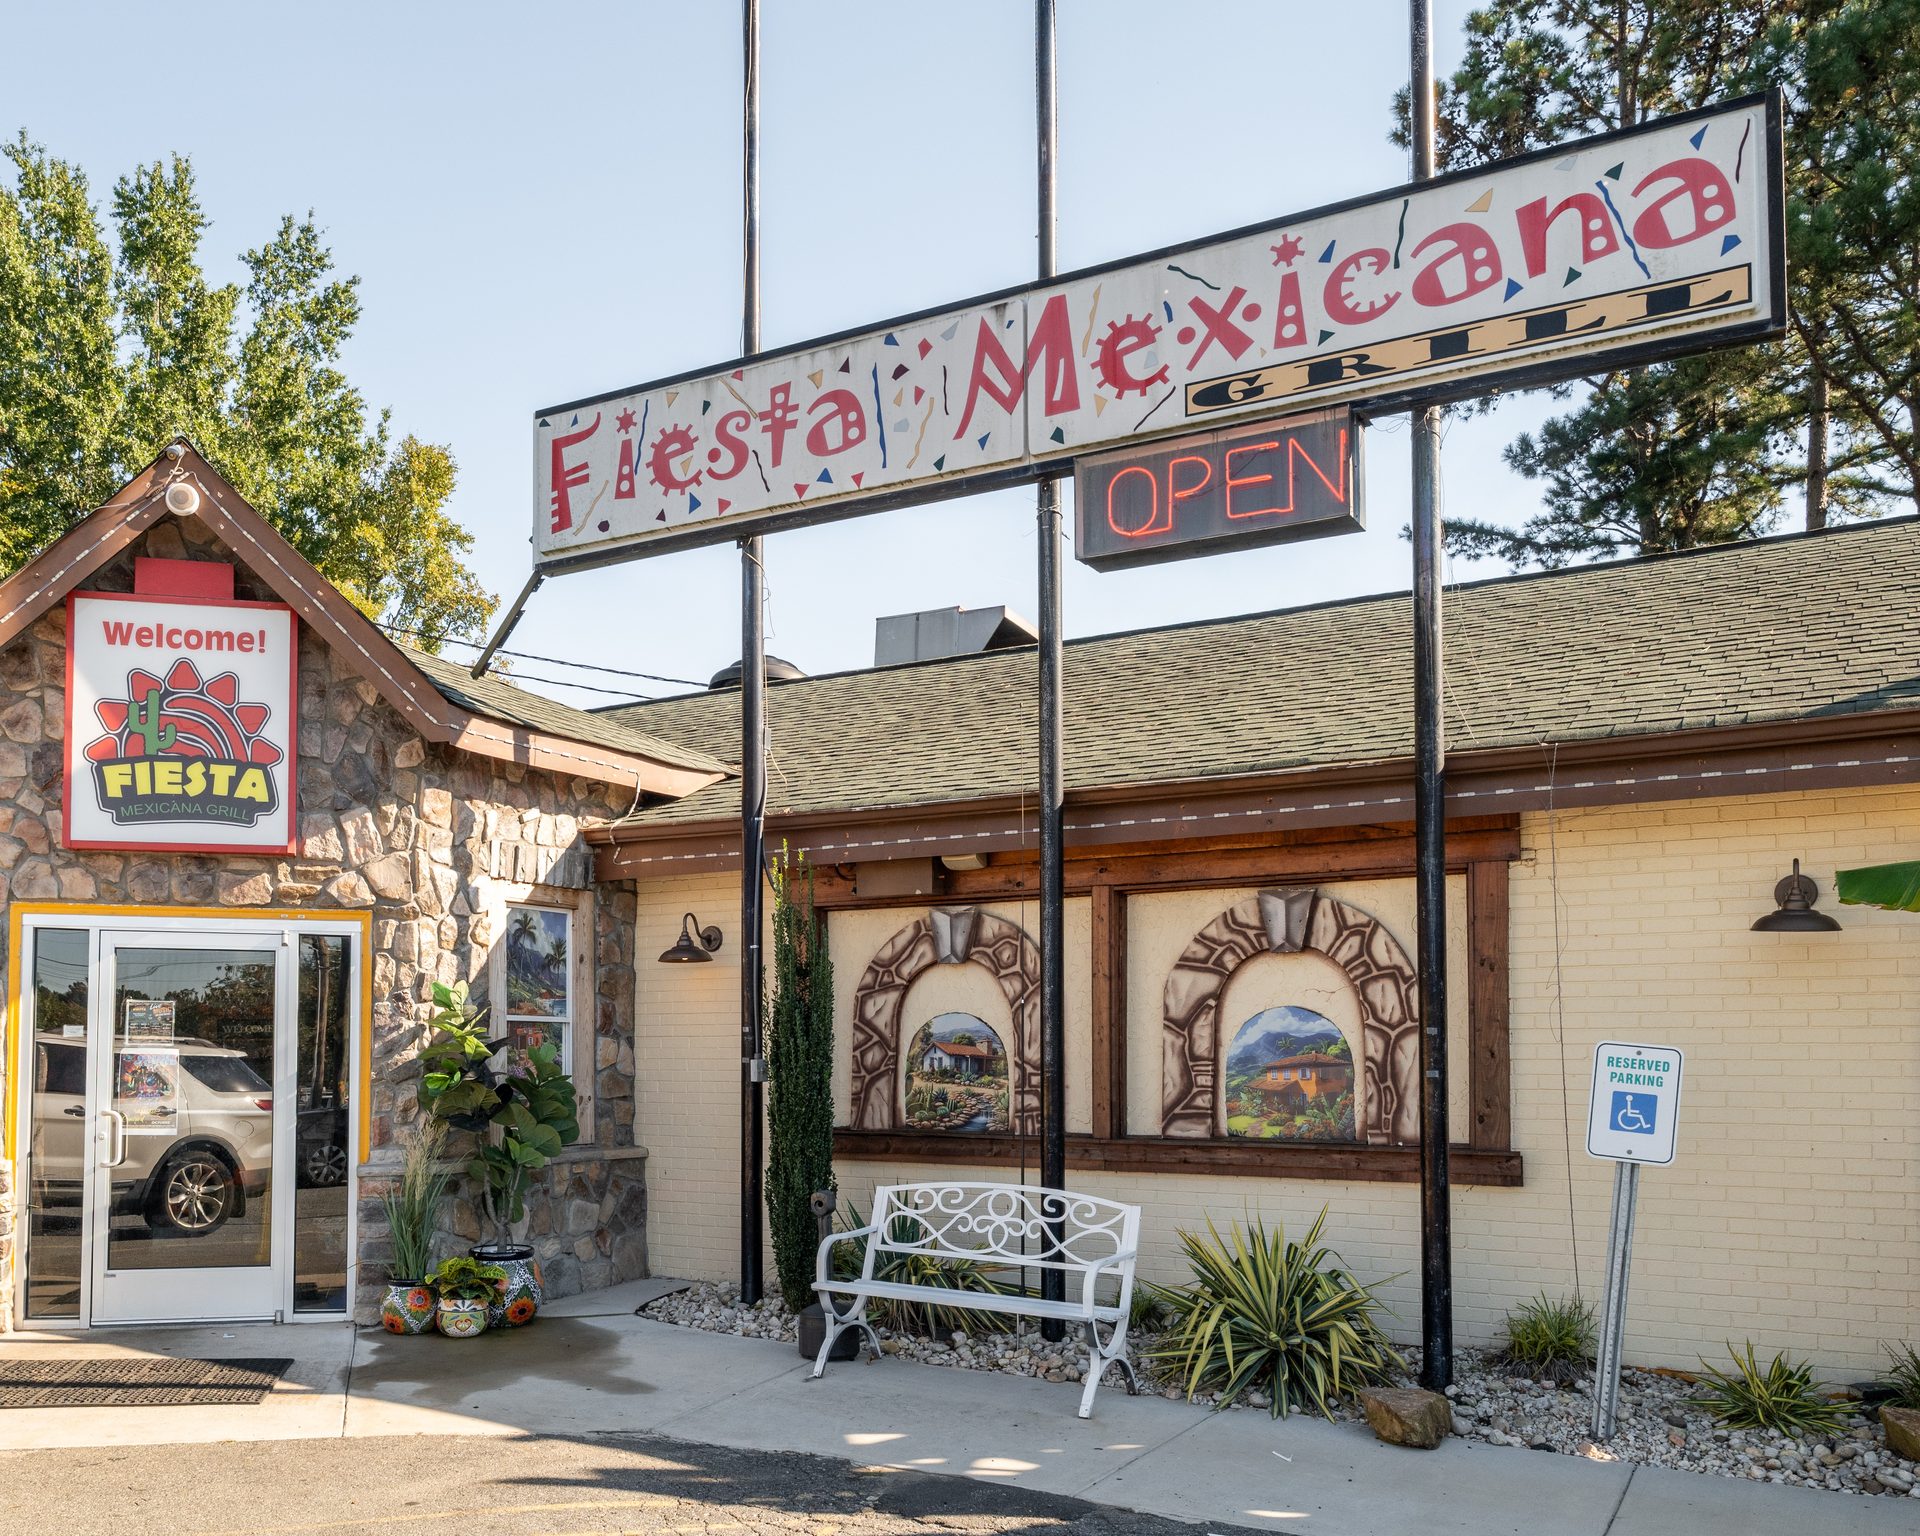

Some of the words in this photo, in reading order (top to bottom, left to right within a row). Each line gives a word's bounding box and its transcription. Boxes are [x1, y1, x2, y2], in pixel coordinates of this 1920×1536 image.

[551, 381, 867, 534] Fiesta
[953, 157, 1737, 440] Mexicana
[1192, 275, 1734, 409] GRILL
[1106, 428, 1348, 538] OPEN
[102, 621, 266, 653] Welcome!
[102, 760, 269, 803] FIESTA
[206, 804, 250, 821] GRILL
[222, 1024, 273, 1034] WELCOME
[1607, 1056, 1670, 1072] RESERVED
[1609, 1071, 1663, 1087] PARKING
